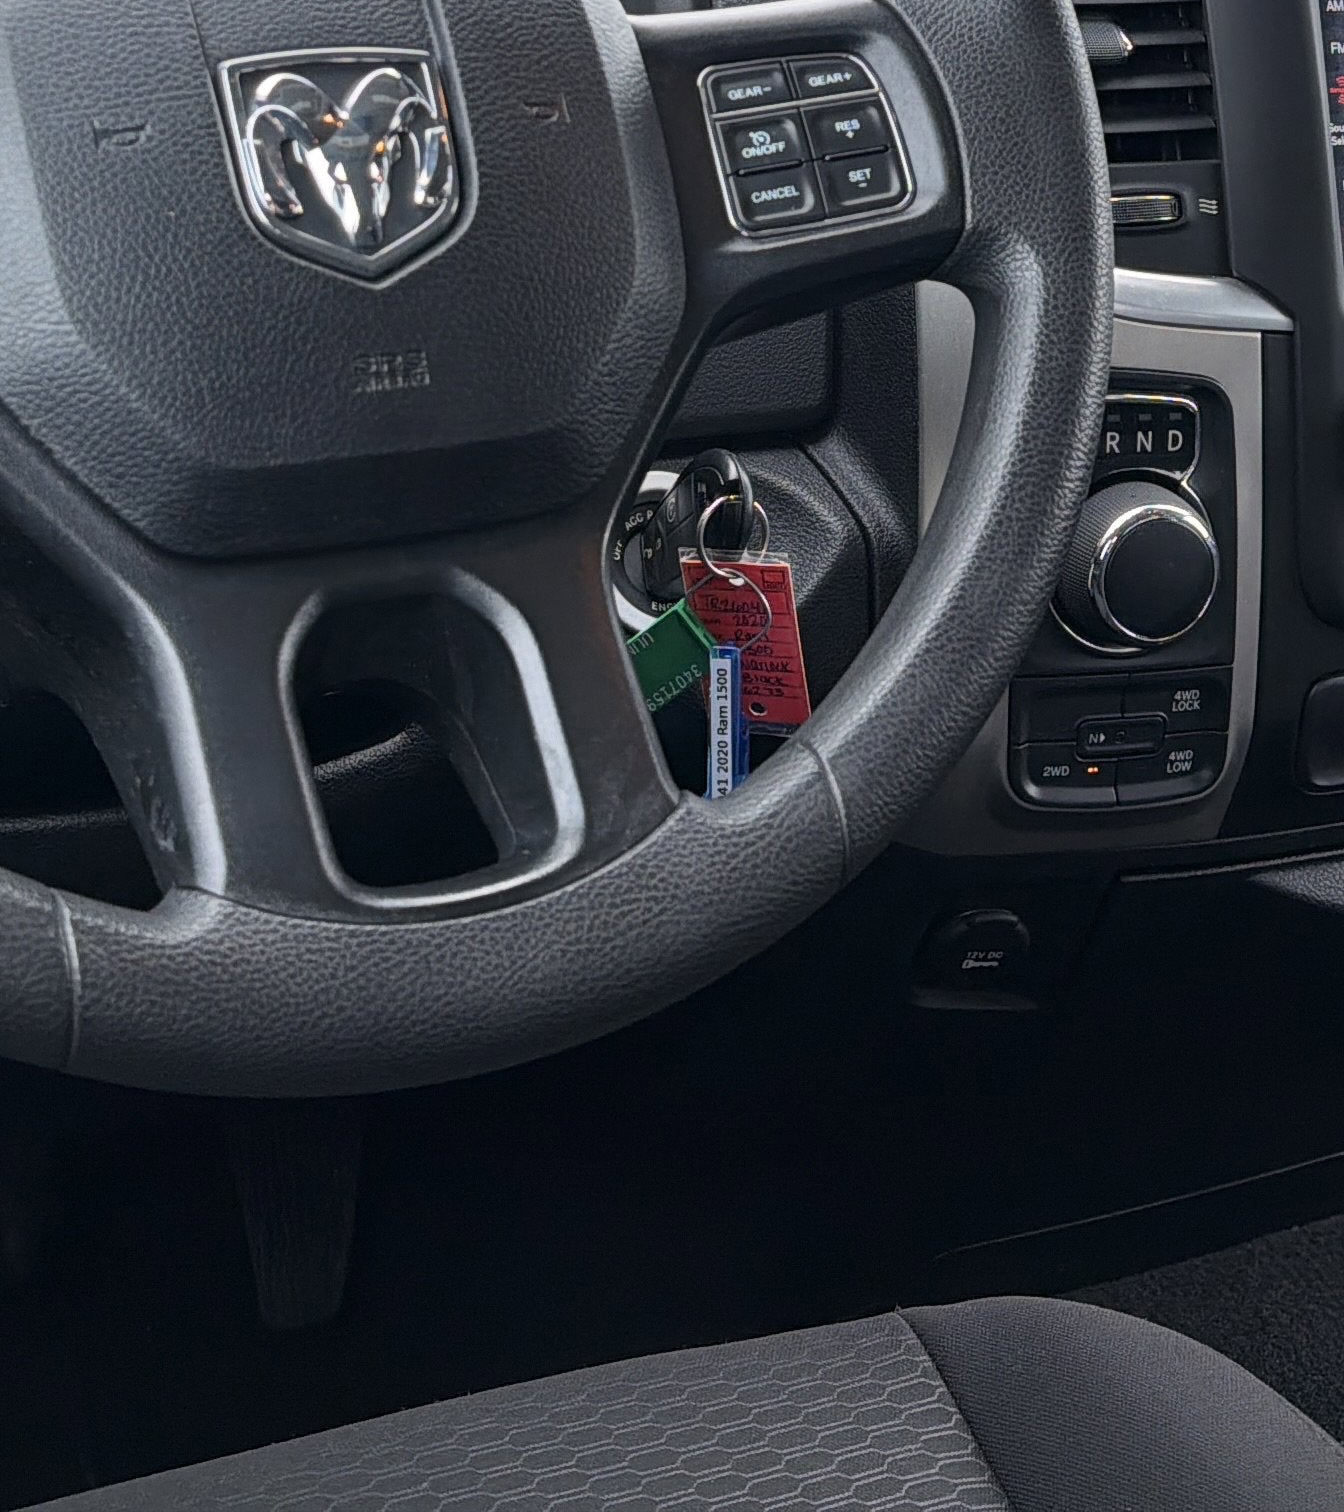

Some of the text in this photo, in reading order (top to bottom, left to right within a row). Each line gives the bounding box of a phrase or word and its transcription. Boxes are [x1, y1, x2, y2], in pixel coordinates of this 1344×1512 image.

[1326, 0, 1344, 12] AM
[834, 118, 861, 133] RES
[741, 141, 786, 159] ON/OFF
[848, 168, 872, 183] SET
[751, 185, 801, 204] CANCEL
[1105, 430, 1183, 454] R N D
[624, 512, 644, 532] ACC
[627, 632, 655, 656] ULIN
[716, 668, 728, 701] 1500
[1173, 689, 1201, 700] 4WD
[1171, 700, 1201, 713] LOCK
[717, 705, 728, 736] Ram
[1088, 733, 1099, 744] N
[717, 740, 729, 773] 2020
[1168, 749, 1194, 761] 4WD
[1042, 766, 1070, 777] 2WD
[1166, 761, 1193, 773] LOW
